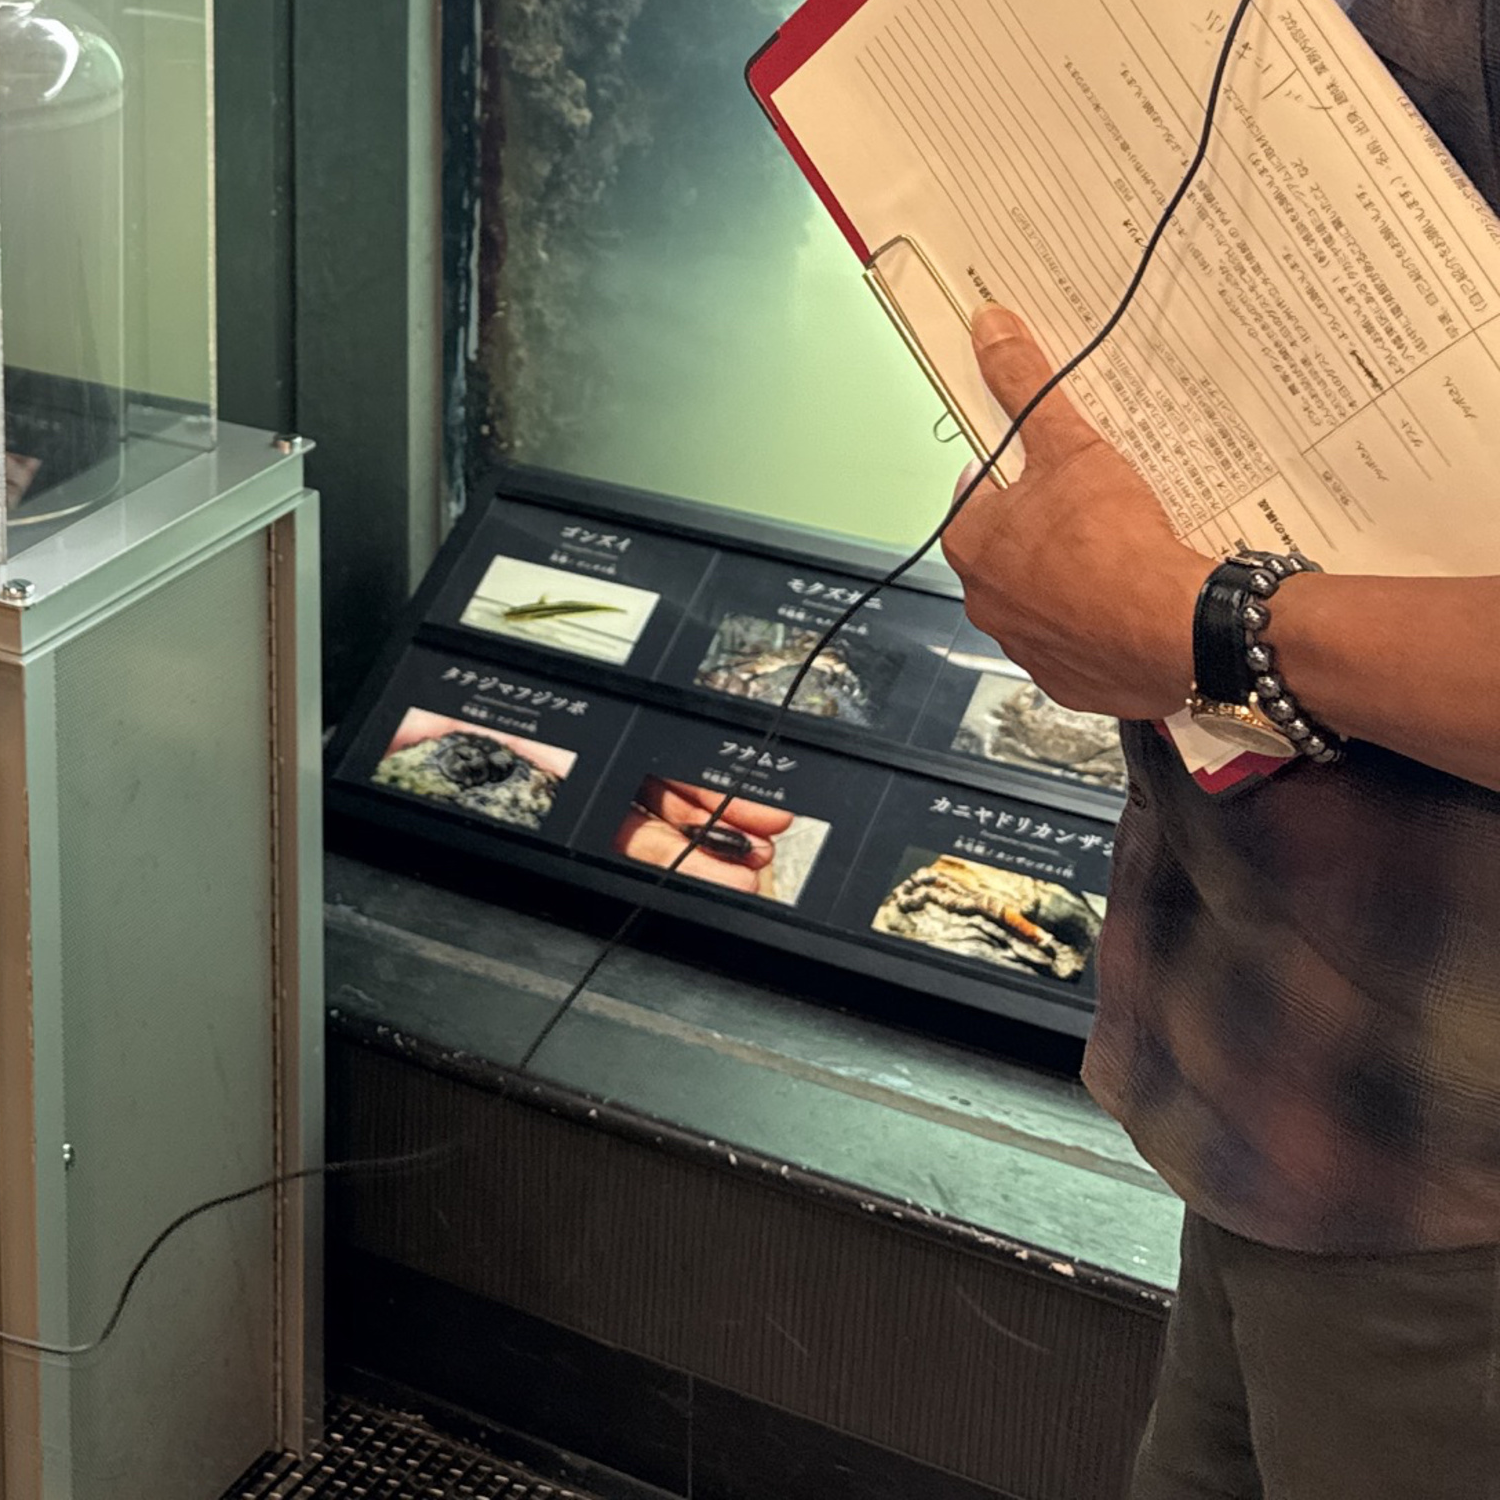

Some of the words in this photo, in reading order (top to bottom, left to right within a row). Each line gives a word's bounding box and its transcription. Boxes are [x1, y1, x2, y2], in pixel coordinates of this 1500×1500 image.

[440, 664, 590, 716] タテジマフジツボ
[717, 739, 798, 773] フナムシ
